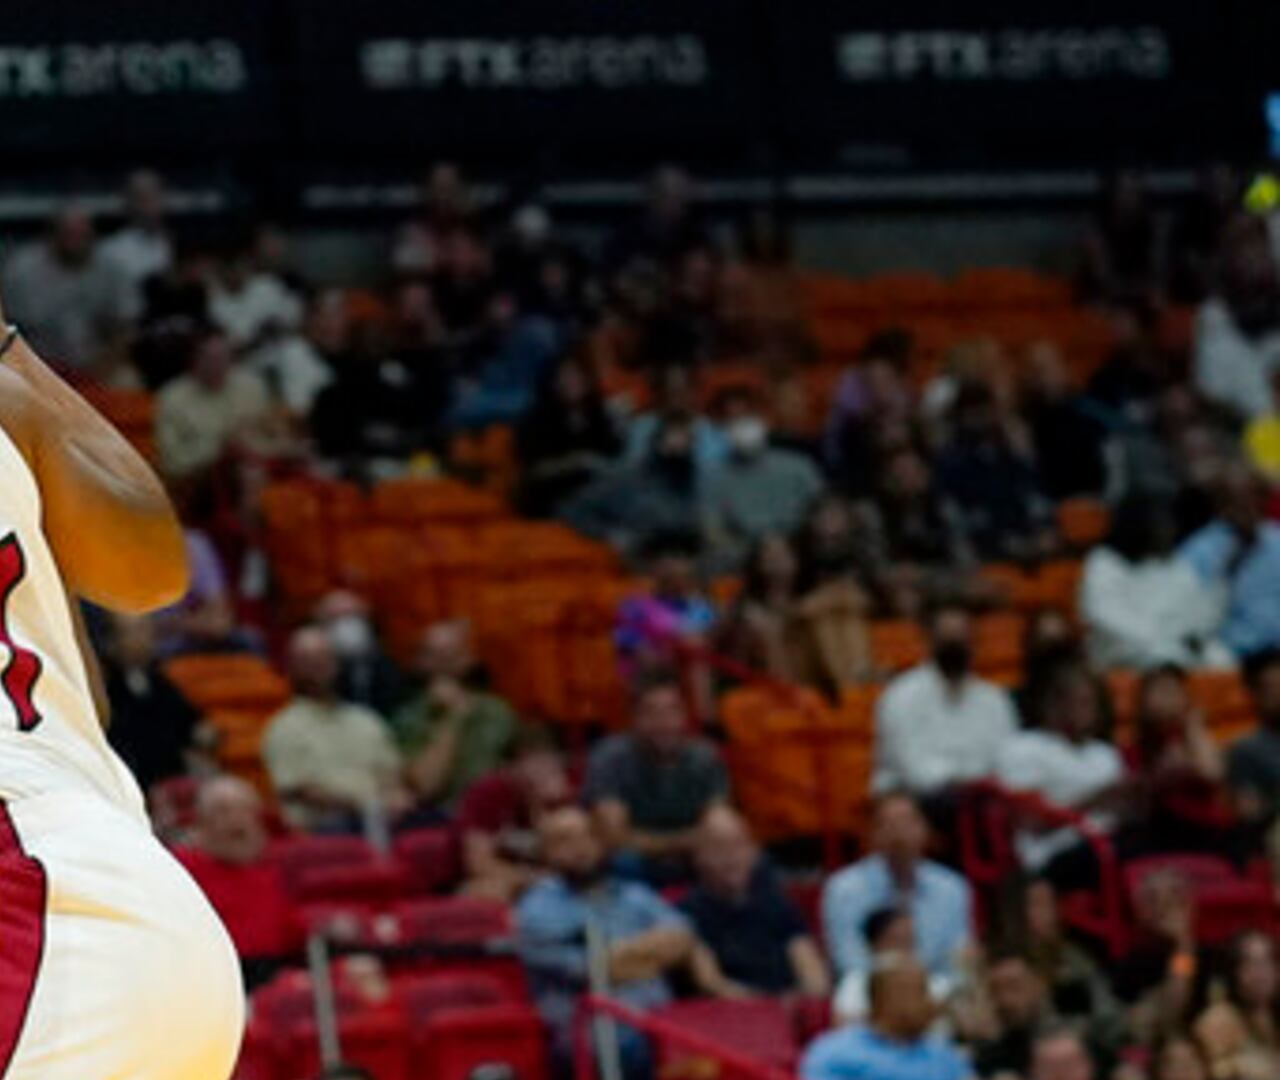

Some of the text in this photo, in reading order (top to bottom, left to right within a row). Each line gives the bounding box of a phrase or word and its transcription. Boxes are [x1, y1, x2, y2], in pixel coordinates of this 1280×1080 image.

[60, 37, 248, 95] arena
[417, 33, 710, 91] FTX arena
